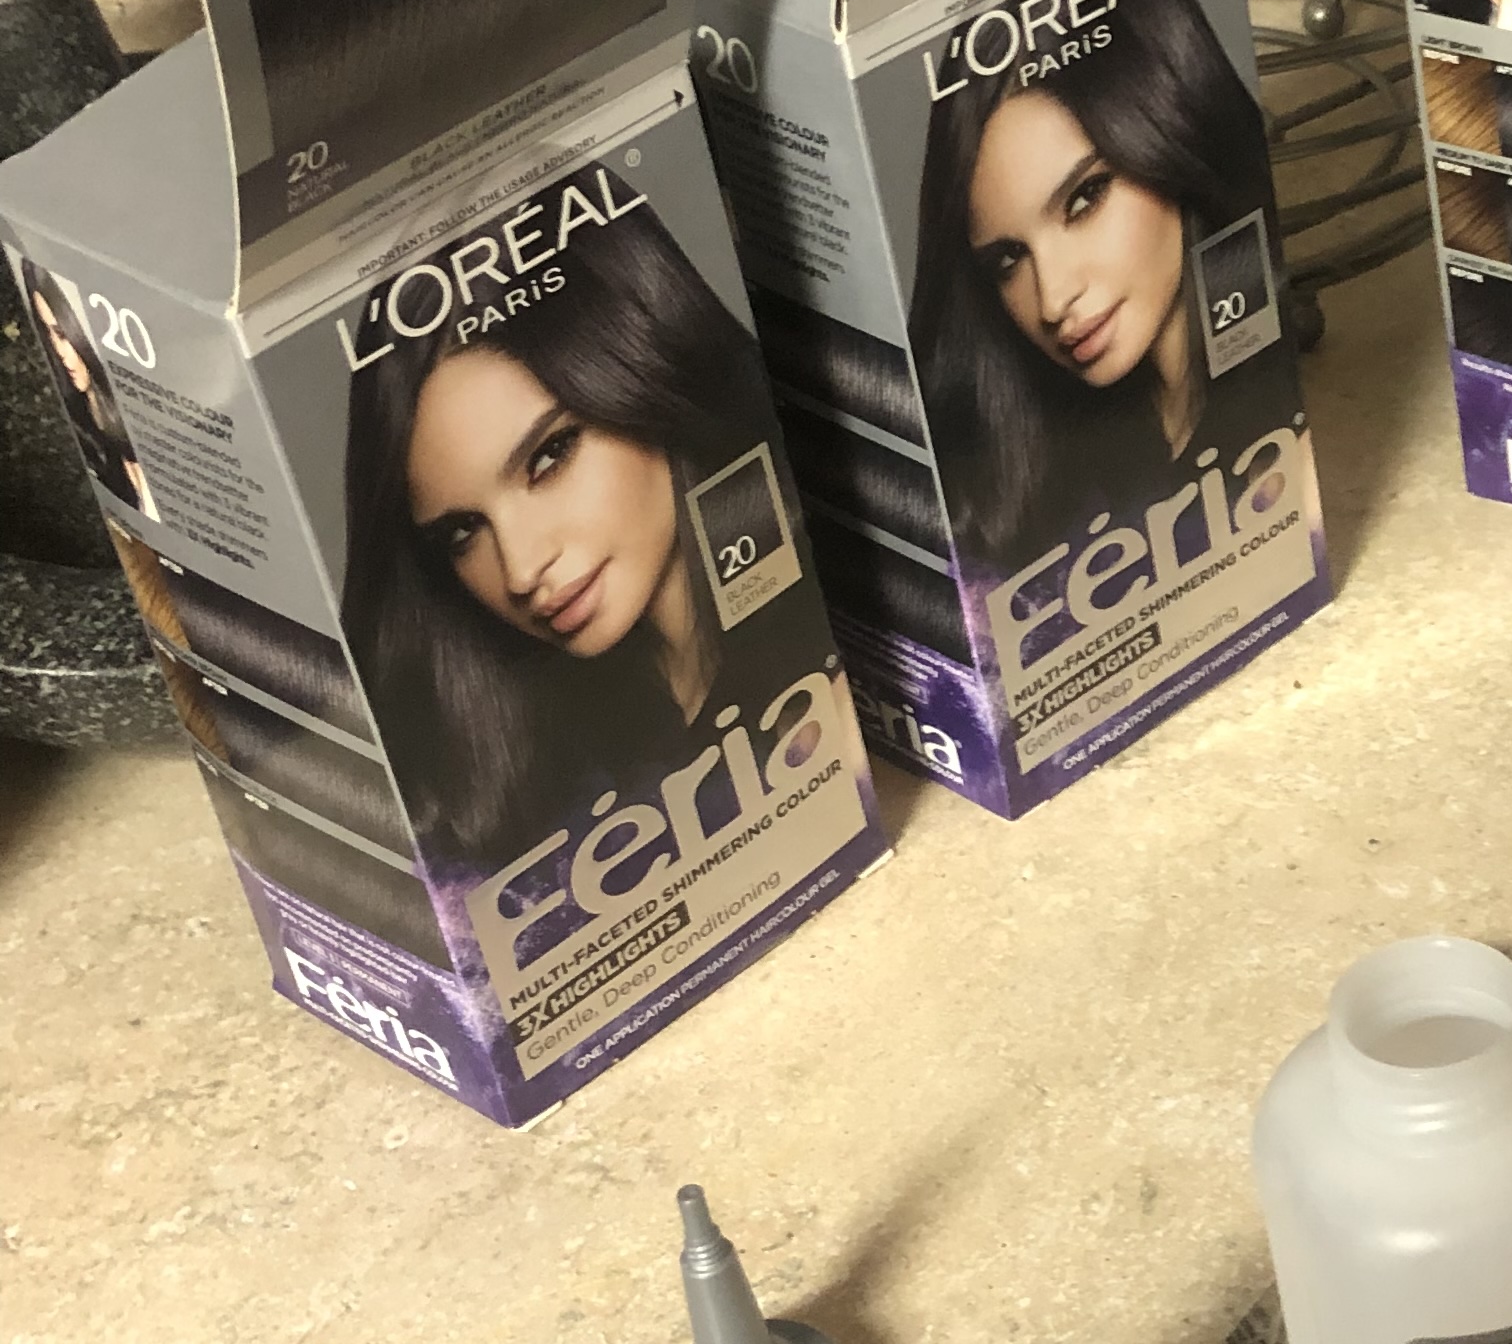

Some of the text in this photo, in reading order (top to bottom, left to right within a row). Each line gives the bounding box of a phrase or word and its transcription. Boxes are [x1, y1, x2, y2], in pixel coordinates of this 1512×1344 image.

[465, 83, 549, 139] LEATHER
[696, 25, 759, 94] 20
[286, 140, 330, 185] 20
[428, 203, 480, 240] FOLLOW
[479, 188, 502, 213] THE
[503, 167, 542, 199] USAGE
[542, 134, 599, 177] ADVISORY
[334, 167, 649, 374] L'ORÉAL
[1211, 291, 1246, 331] 20
[87, 292, 157, 370] 20
[179, 395, 236, 429] COLOUR
[718, 534, 757, 579] 20
[725, 571, 764, 603] BLACK
[729, 576, 779, 617] LEATHER
[988, 423, 1304, 672] Féria
[1014, 616, 1136, 707] MULTI-FACETED
[1138, 549, 1237, 623] SHIMMERING
[1239, 509, 1300, 557] COLOUR
[1024, 605, 1240, 756] Gentle, Deep Conditioning
[1043, 632, 1156, 716] HIGHLIGHTS
[1062, 748, 1087, 771] ONE
[1087, 706, 1152, 754] APPLICATION
[1151, 670, 1208, 712] PERMANENT
[468, 670, 844, 971] Féria
[509, 898, 658, 1010] MULTI-FACETED
[662, 813, 774, 903] SHIMMERING
[775, 758, 843, 819] COLOUR
[283, 946, 456, 1082] Féria
[516, 908, 682, 1038] 3X HIGHLIGHTS
[526, 869, 782, 1060] Gentle, Deep Conditioning
[575, 868, 842, 1069] ONE APPLICATION PERMANENT HAIRCOLOUR GEL
